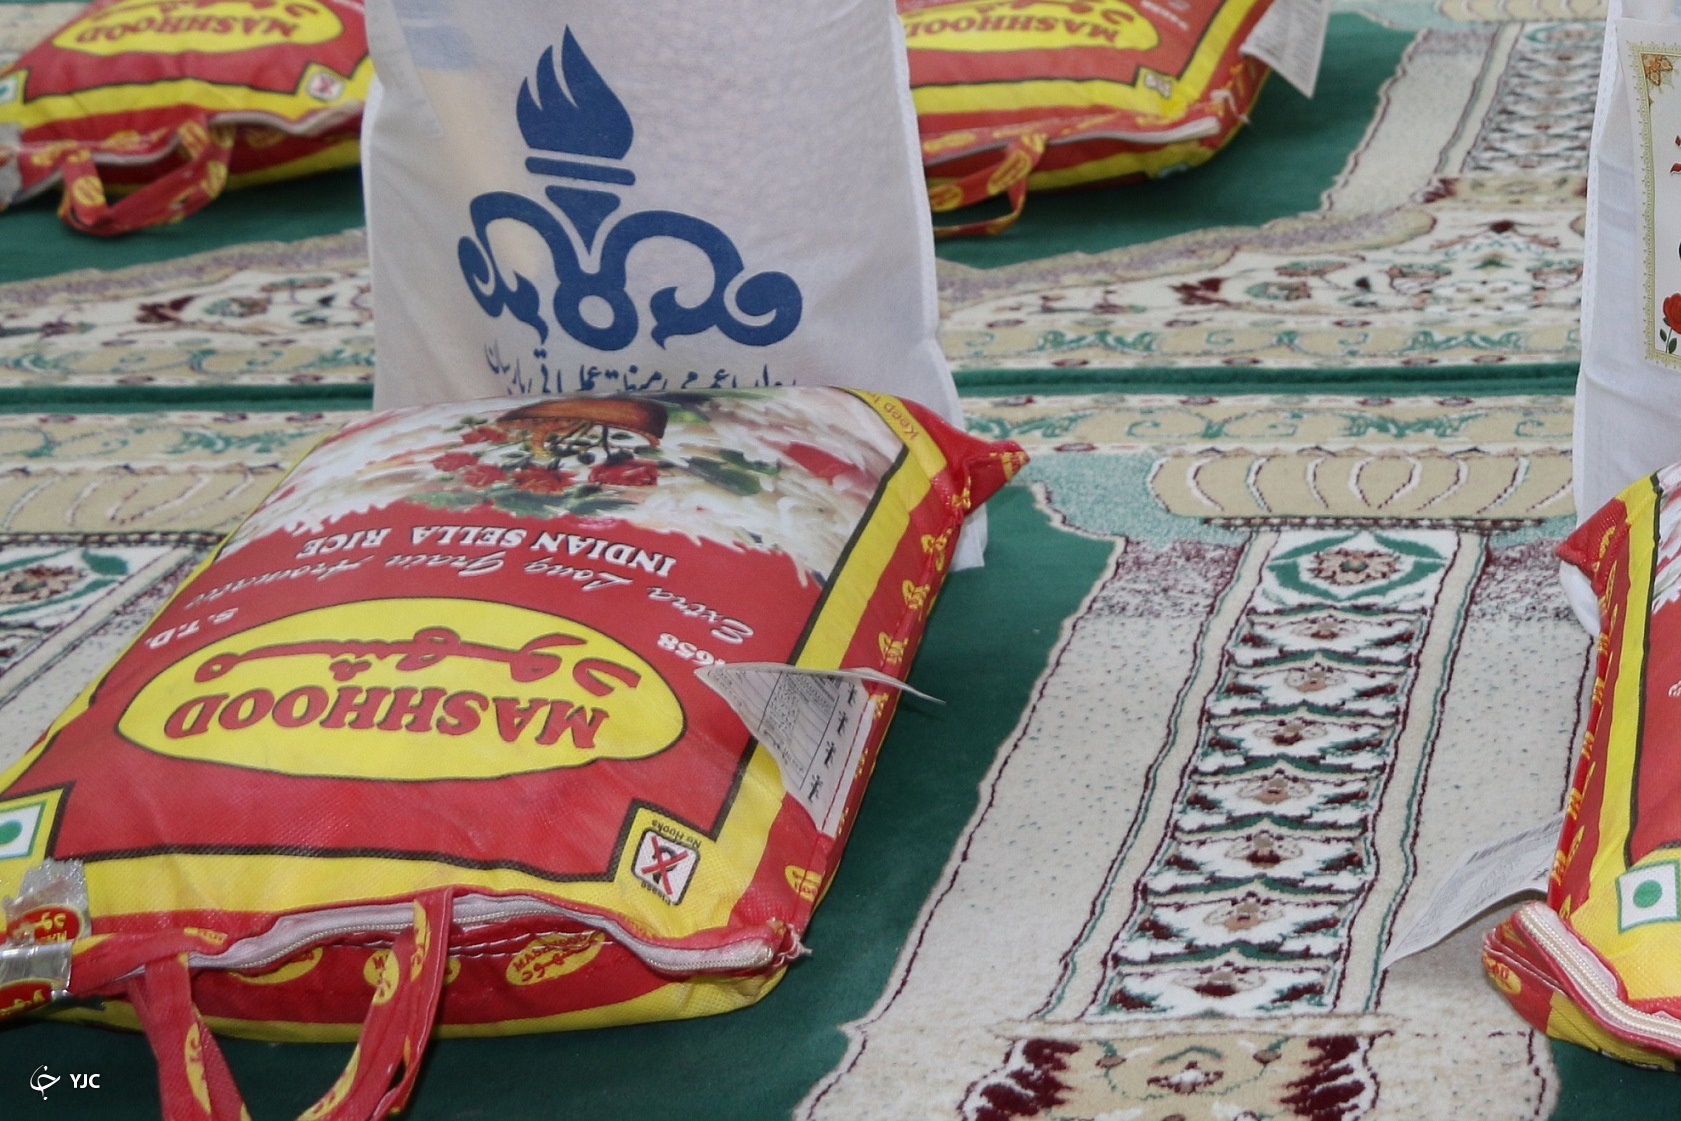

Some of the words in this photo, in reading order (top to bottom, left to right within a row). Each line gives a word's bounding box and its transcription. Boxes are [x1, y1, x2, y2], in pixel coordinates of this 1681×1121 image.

[76, 17, 300, 44] MASHHOOD
[294, 527, 385, 559] RICE
[411, 525, 526, 550] SELLA
[525, 528, 677, 578] INDIAN
[385, 551, 505, 578] Grain
[524, 556, 633, 592] Long
[646, 585, 755, 646] Extra
[193, 627, 642, 697] مشهود
[162, 682, 609, 750] MASHHOOD
